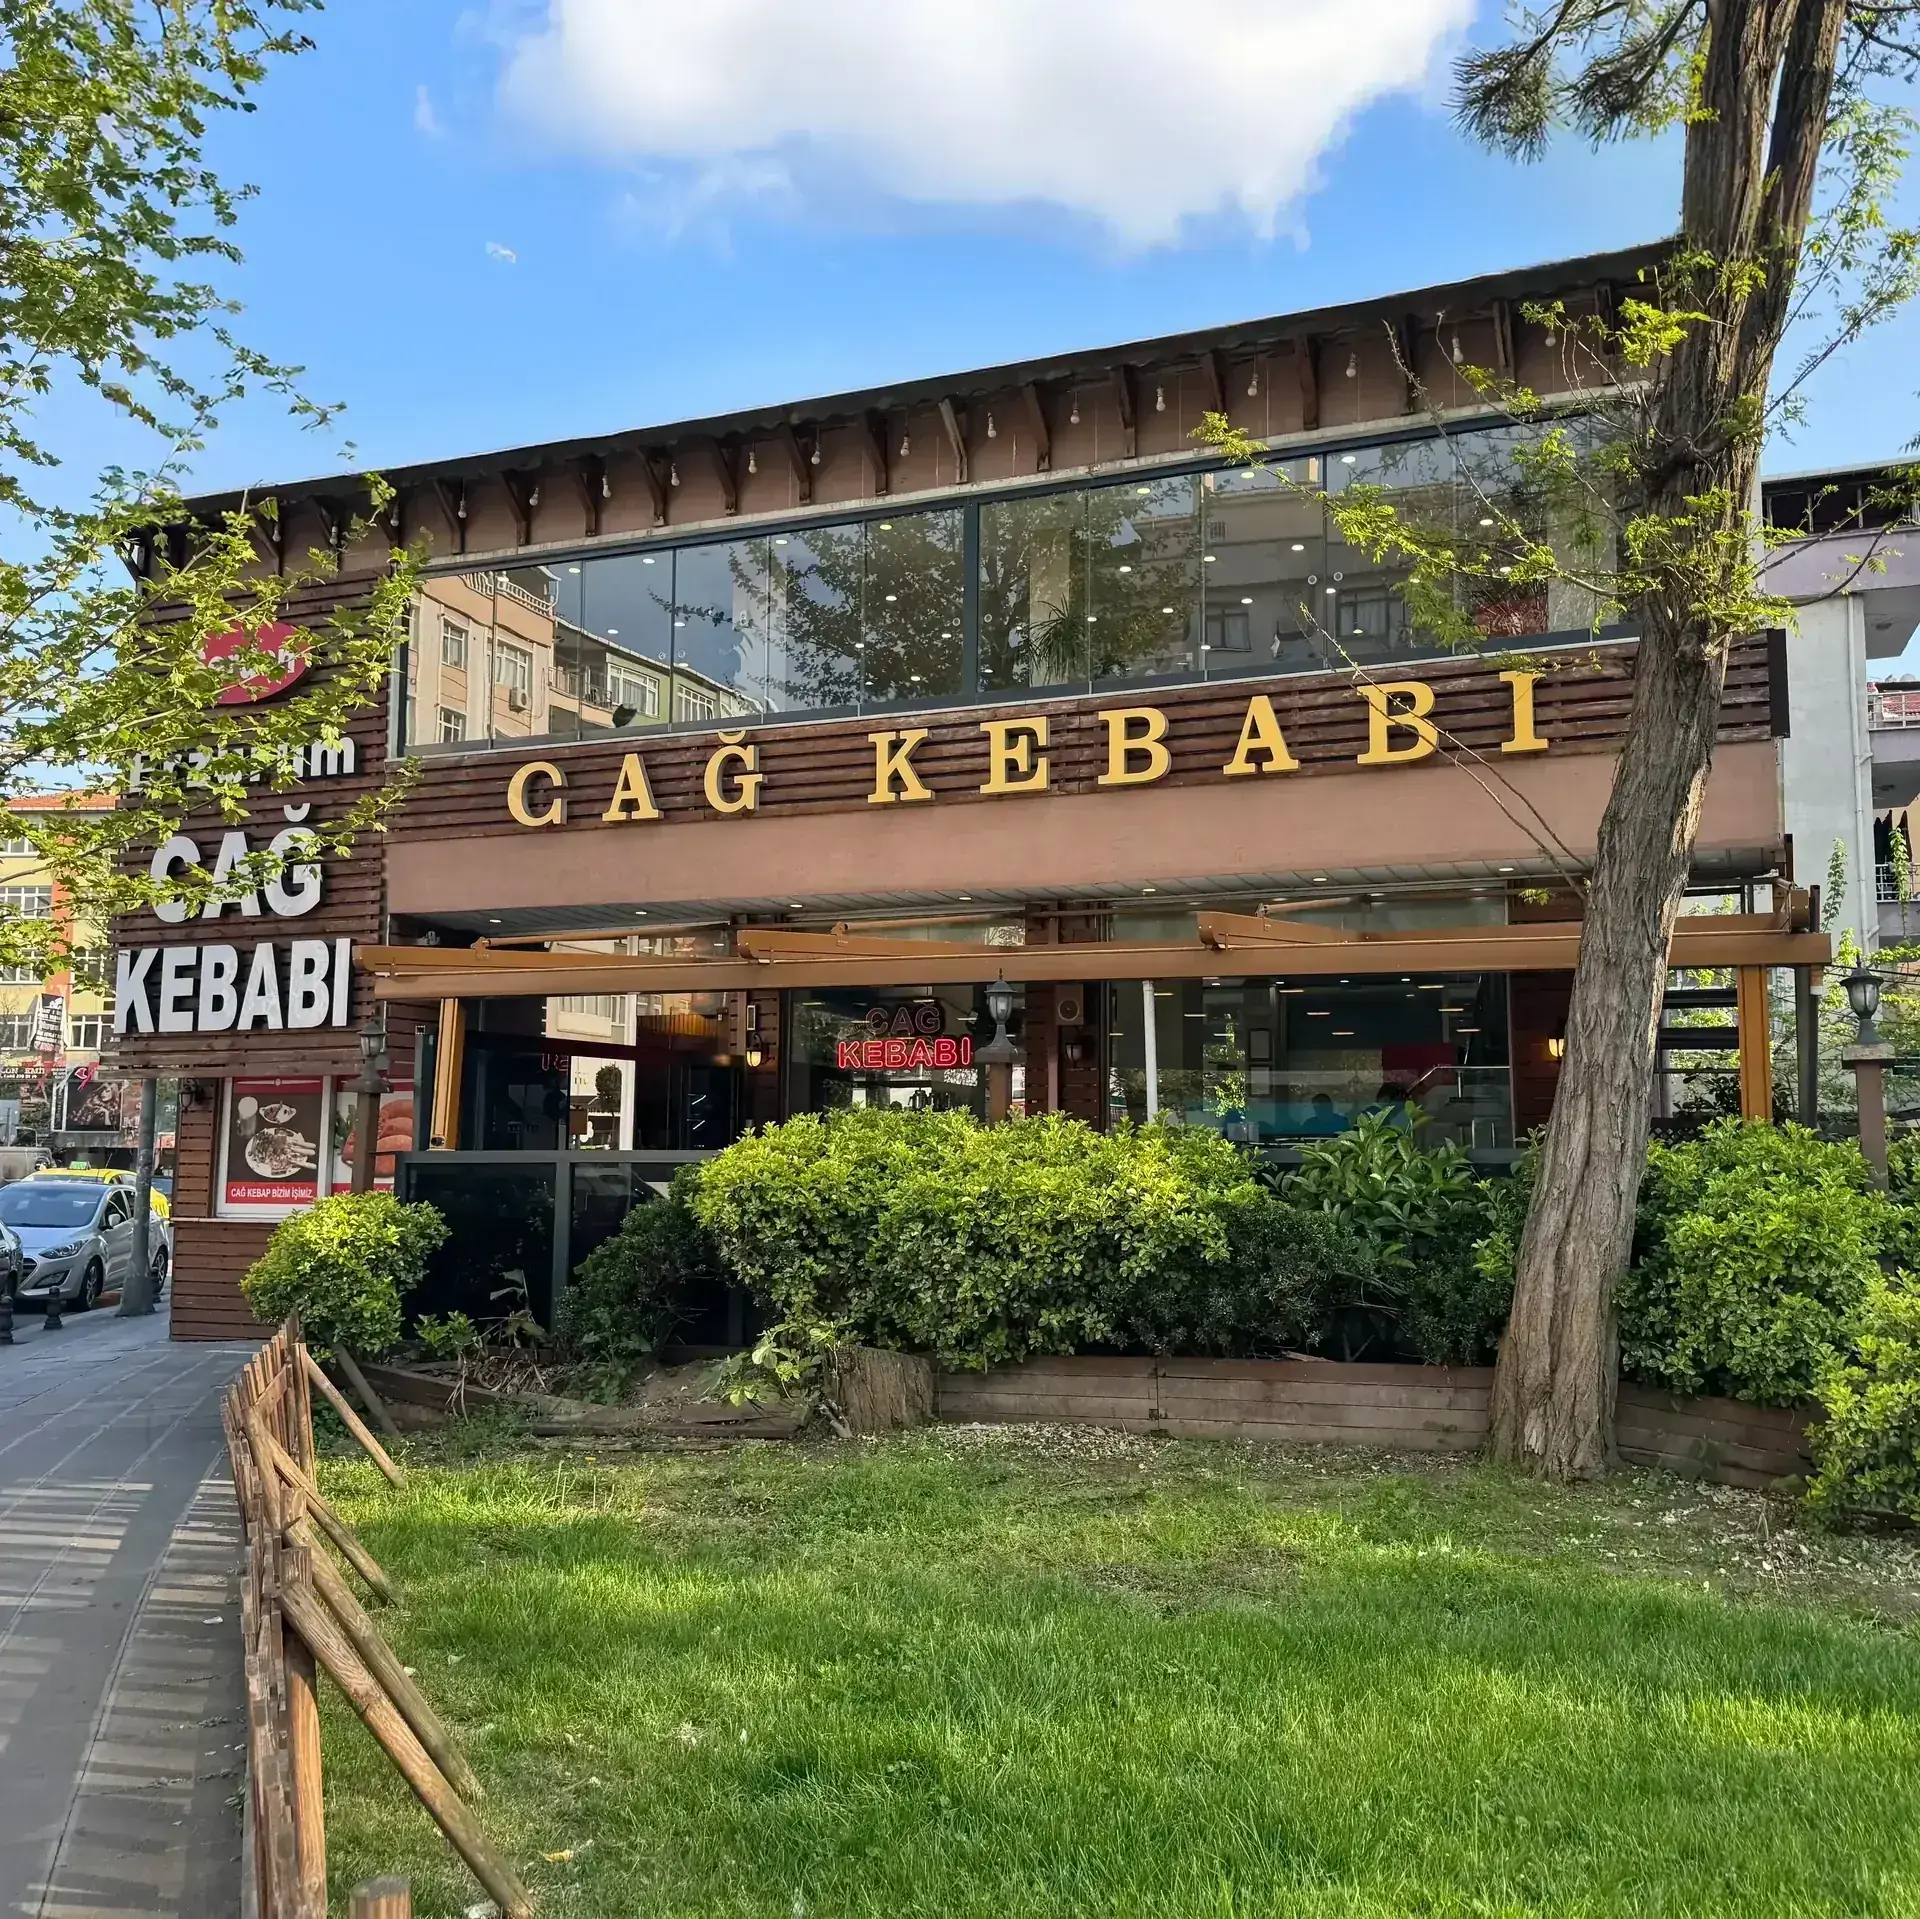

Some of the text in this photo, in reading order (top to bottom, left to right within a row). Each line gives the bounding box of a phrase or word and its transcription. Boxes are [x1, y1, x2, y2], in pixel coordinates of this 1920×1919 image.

[867, 671, 1548, 804] KEBABI
[114, 938, 351, 1034] KEBABI
[838, 1037, 972, 1069] KEBABI
[247, 1187, 271, 1198] KEBAP
[271, 1186, 291, 1198] BİZİM
